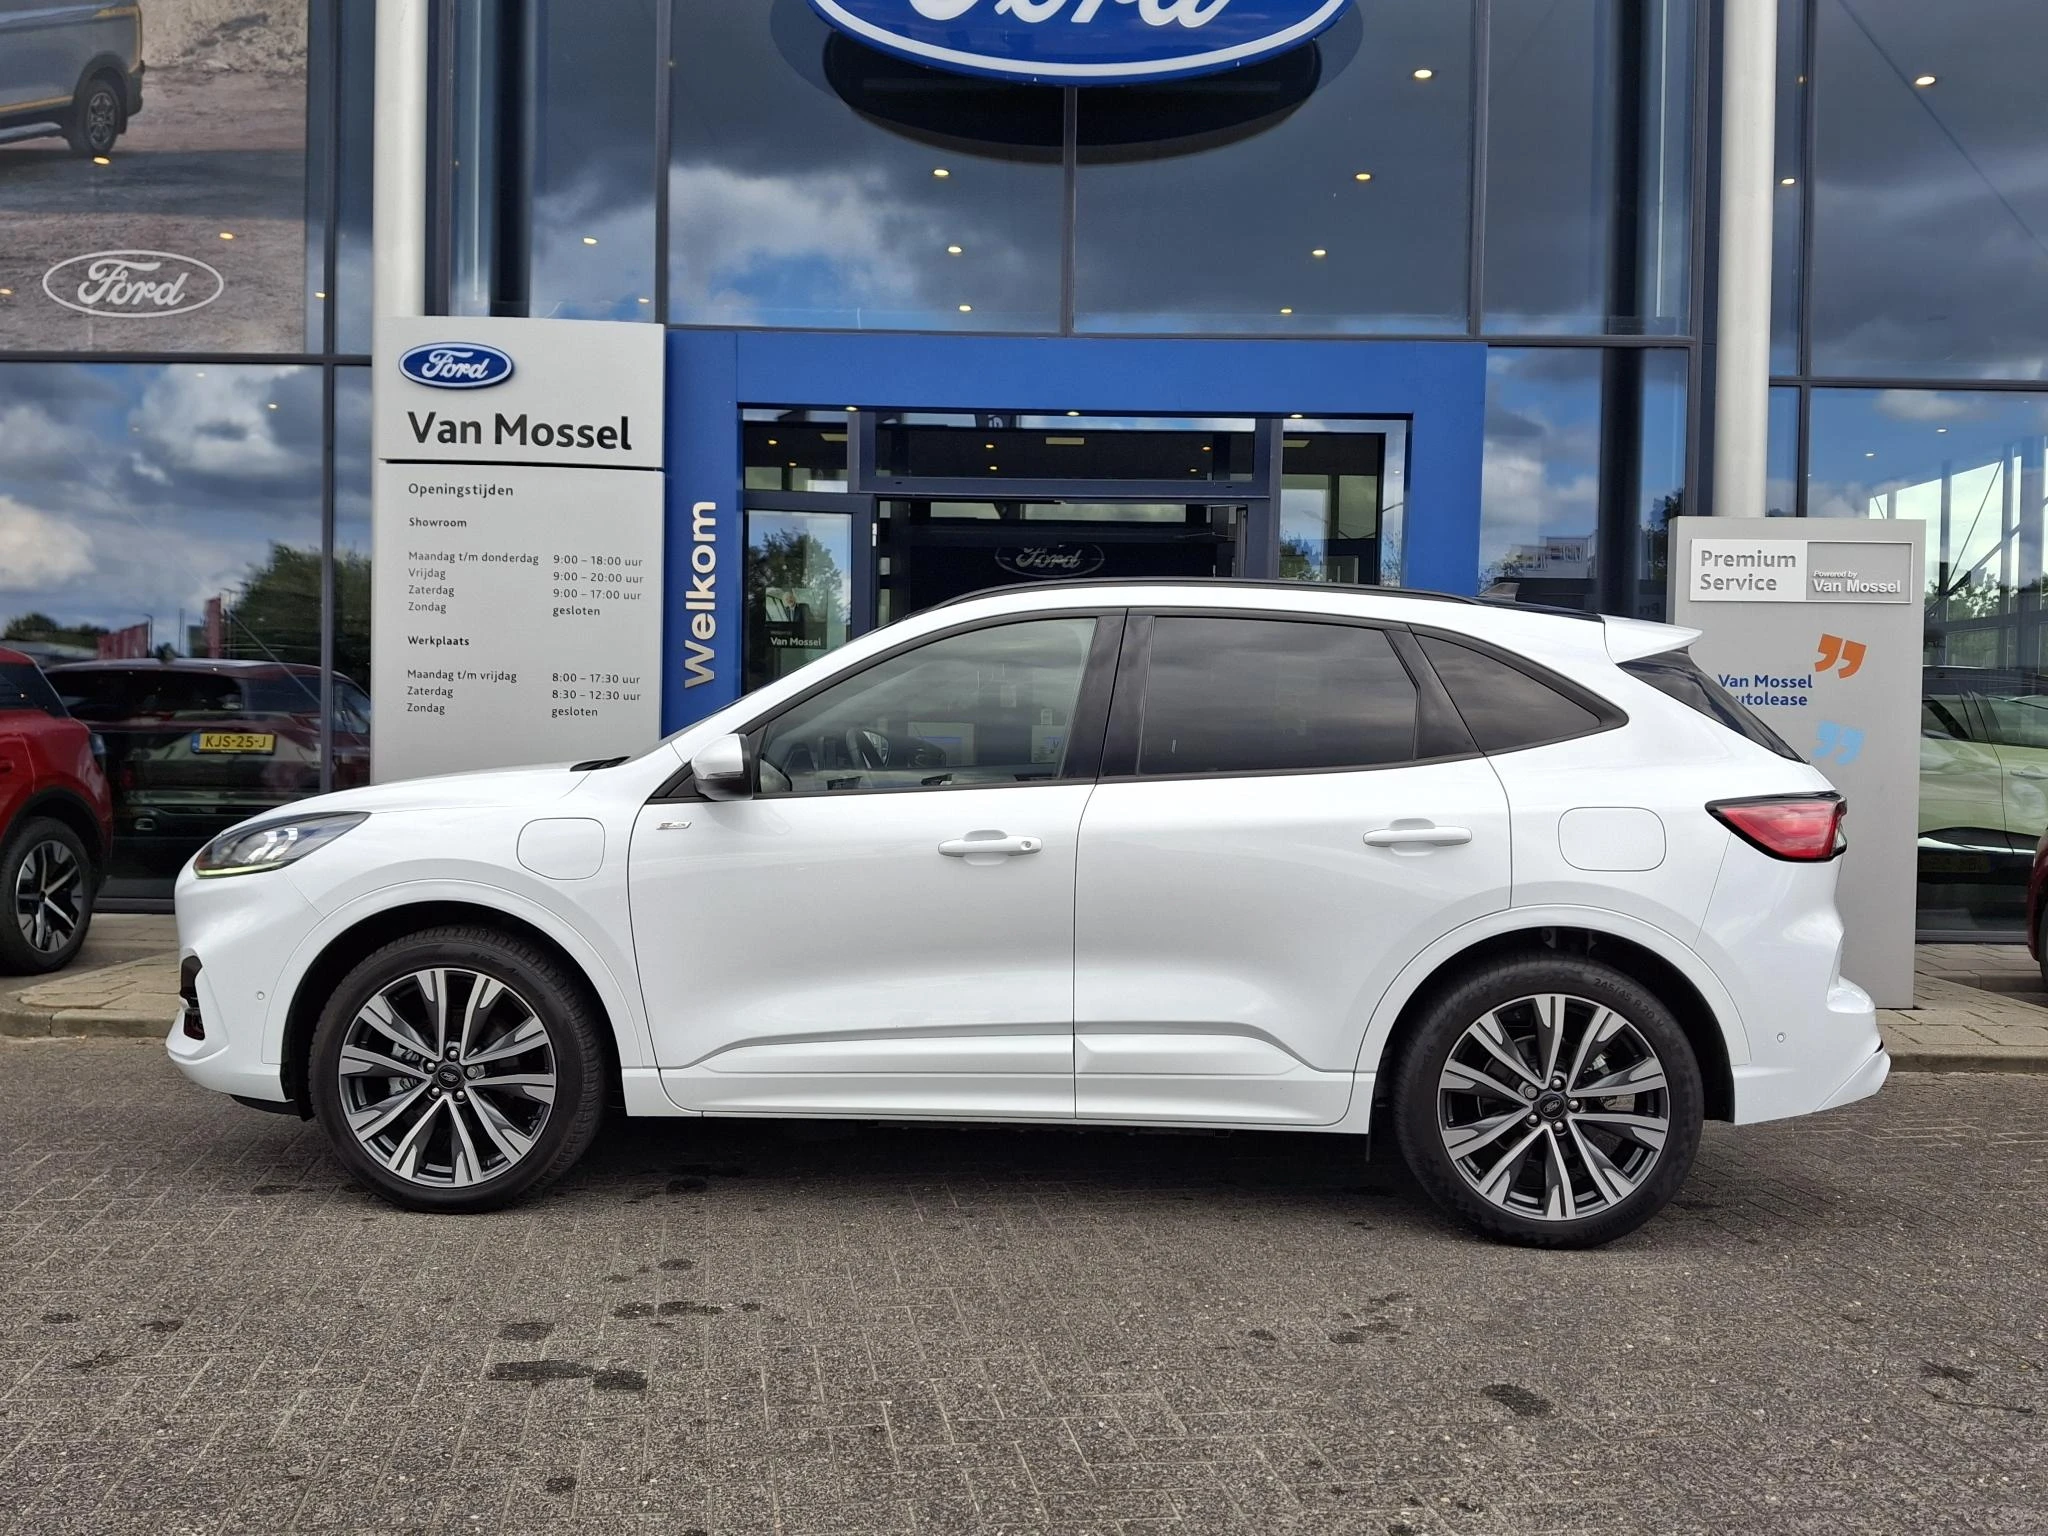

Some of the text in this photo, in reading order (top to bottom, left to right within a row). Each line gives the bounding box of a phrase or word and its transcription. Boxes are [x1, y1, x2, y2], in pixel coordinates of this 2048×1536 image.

[77, 258, 189, 306] Ford
[421, 349, 490, 379] Ford
[407, 411, 632, 450] Van Mossel
[408, 482, 514, 498] Openingstijden
[408, 516, 467, 529] Showroom
[408, 552, 455, 564] Maandag
[459, 552, 478, 561] t/m
[481, 552, 539, 566] donderdag
[553, 554, 578, 565] 9:00
[591, 555, 621, 566] 18:00
[624, 559, 643, 567] uur
[1700, 549, 1797, 568] Premium
[408, 567, 446, 580] Vrijdag
[553, 571, 578, 581] 9:00
[590, 572, 622, 583] 20:00
[625, 576, 644, 584] uur
[1700, 573, 1777, 591] Service
[1813, 570, 1858, 579] Powered by
[408, 584, 455, 597] Zaterdag
[553, 588, 578, 598] 9:00
[591, 589, 620, 600] 17:00
[1813, 580, 1901, 593] Van Mossel
[684, 501, 717, 689] Welkom
[408, 601, 600, 617] Zondag gesloten
[407, 635, 470, 647] Werkplaats
[769, 637, 821, 647] Van Mossel
[407, 669, 454, 681] Maandag
[457, 670, 477, 680] t/m
[480, 671, 517, 683] vrijdag
[552, 672, 577, 683] 8:00
[589, 674, 619, 684] 17:30
[622, 676, 641, 684] uur
[1718, 674, 1813, 688] Van Mossel
[407, 685, 454, 699] Zaterdag
[552, 689, 577, 700] 8:30
[589, 691, 620, 701] 12:30
[406, 702, 598, 719] Zondag gesloten
[205, 735, 267, 748] KJS-25-J
